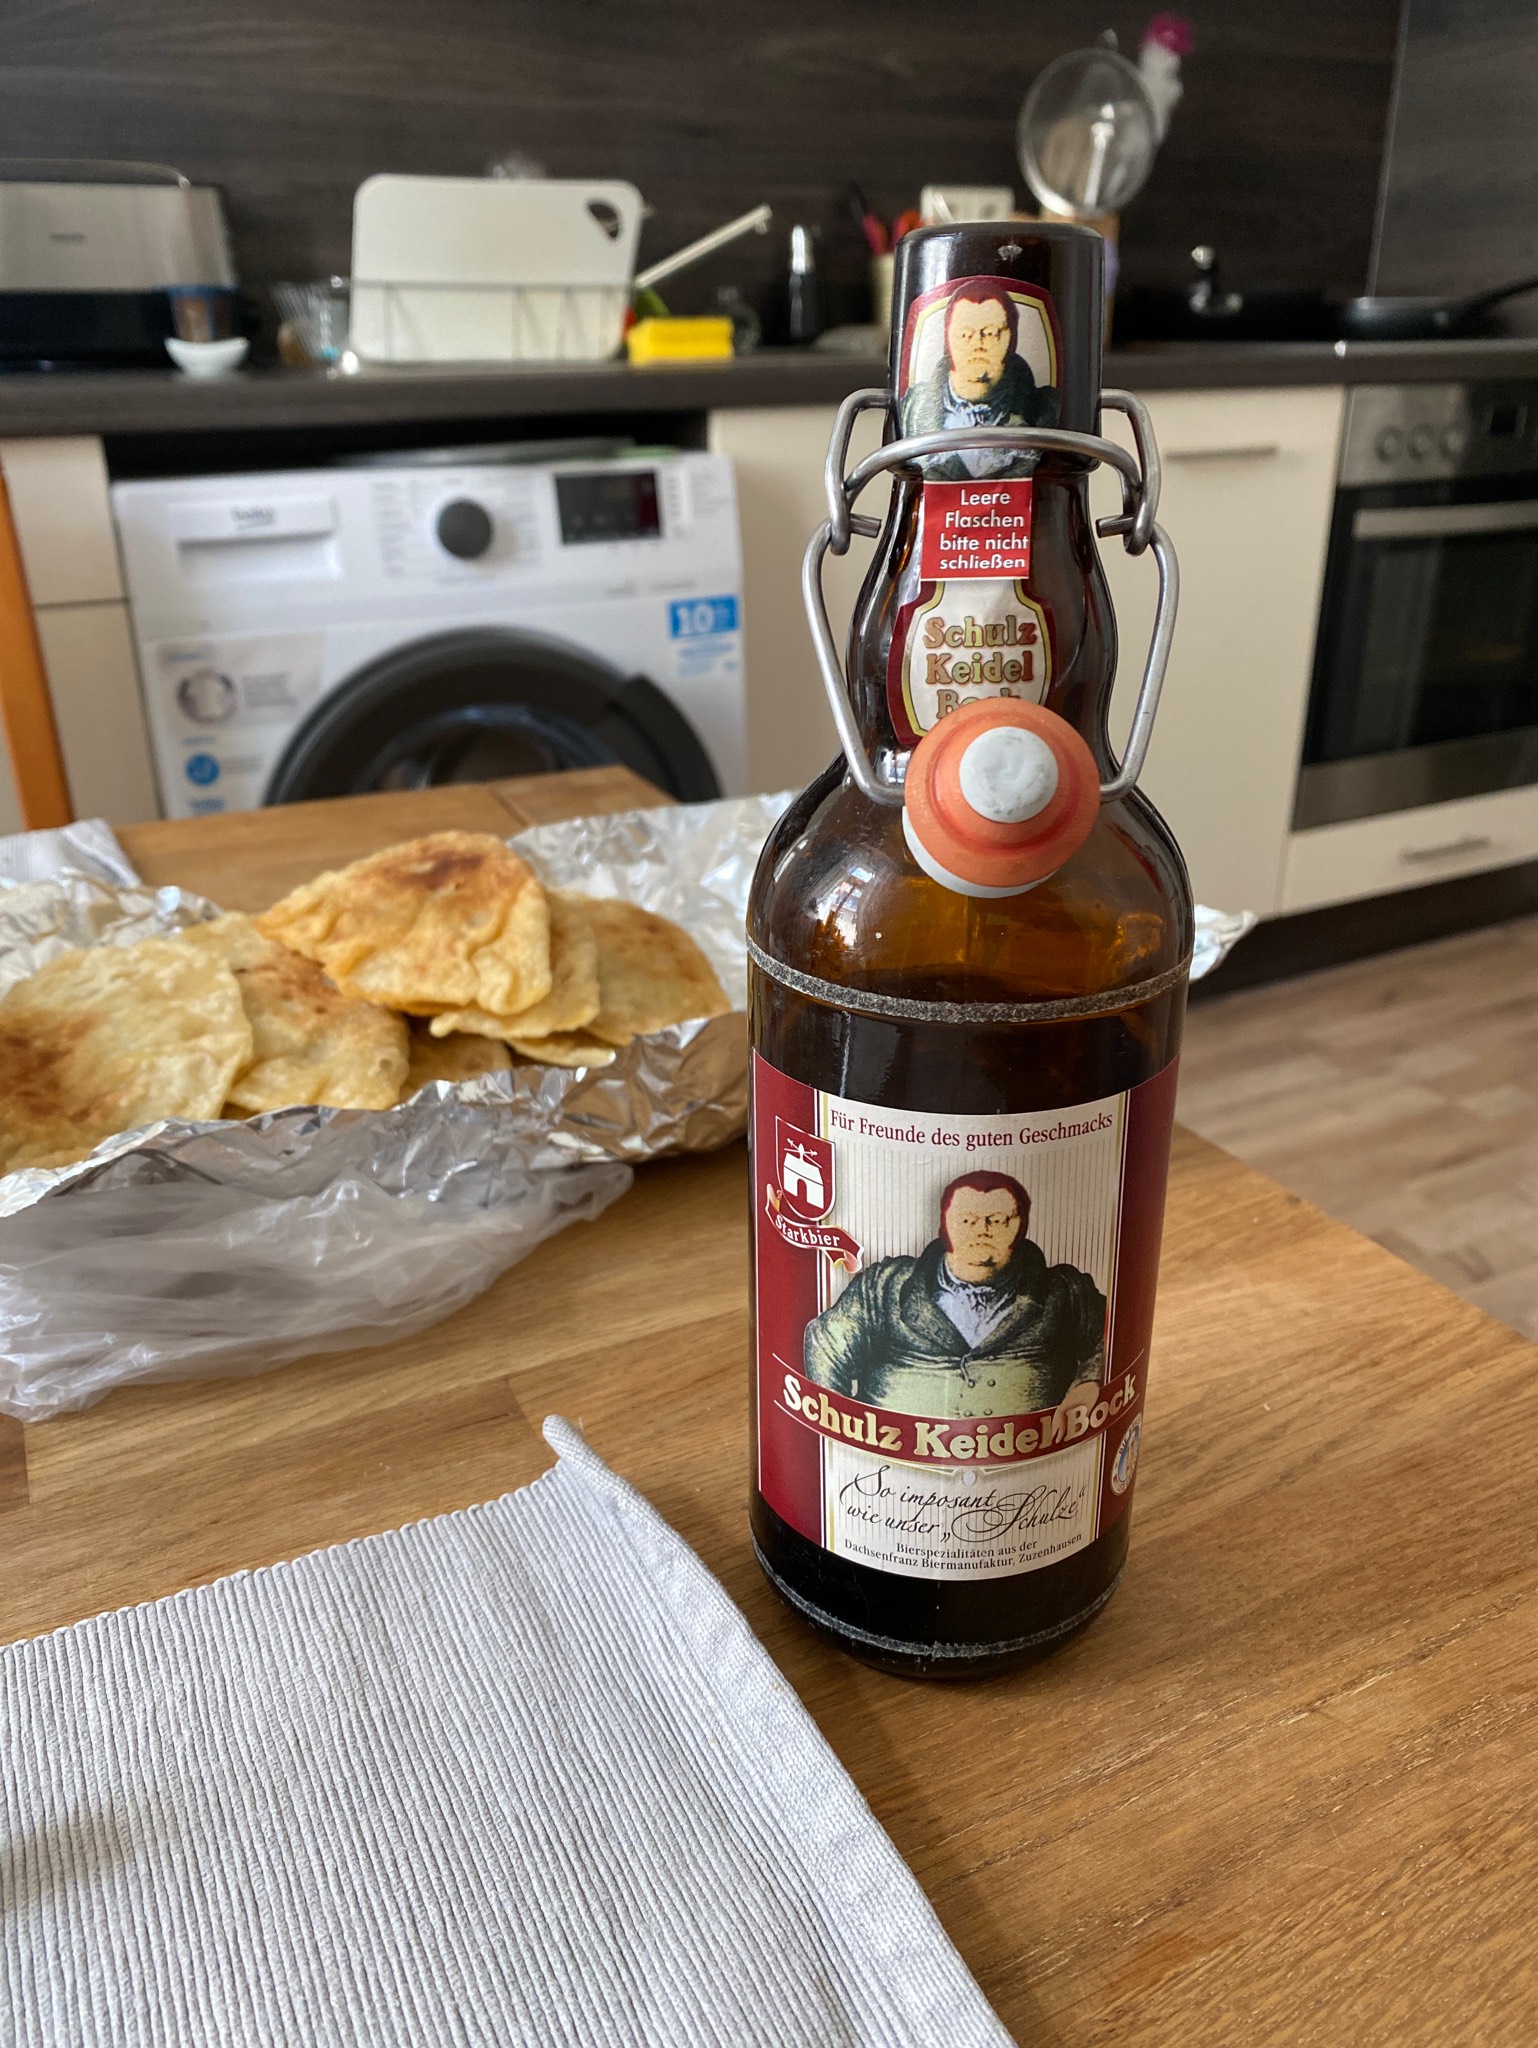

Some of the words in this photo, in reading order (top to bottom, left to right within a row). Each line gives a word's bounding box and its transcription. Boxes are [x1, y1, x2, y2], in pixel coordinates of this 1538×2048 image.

[960, 489, 1011, 506] Leere
[945, 509, 1025, 528] Flaschen
[940, 532, 979, 551] bitte
[985, 532, 1029, 550] nicht
[940, 554, 1025, 570] schließen
[923, 614, 1038, 649] Schulz
[925, 650, 1034, 684] Keidel
[830, 1109, 855, 1131] Für
[859, 1117, 925, 1145] Freunde
[931, 1127, 960, 1147] des
[966, 1131, 1013, 1151] guten
[1019, 1112, 1113, 1145] Geschmacks
[775, 1214, 840, 1247] Starkbier
[783, 1375, 903, 1452] Schulz
[914, 1411, 1054, 1460] Keidel
[1063, 1373, 1137, 1442] Bock
[840, 1465, 895, 1506] So
[900, 1486, 999, 1522] imposant
[847, 1504, 882, 1524] wie
[885, 1515, 941, 1534] unser
[844, 1538, 919, 1567] Dachsenfranz
[921, 1557, 1016, 1571] Biermanufaktur,
[1018, 1533, 1083, 1563] Zuzenhausen
[896, 1542, 995, 1559] Bierspezialitäten
[998, 1546, 1017, 1556] aus
[1019, 1540, 1038, 1552] der
